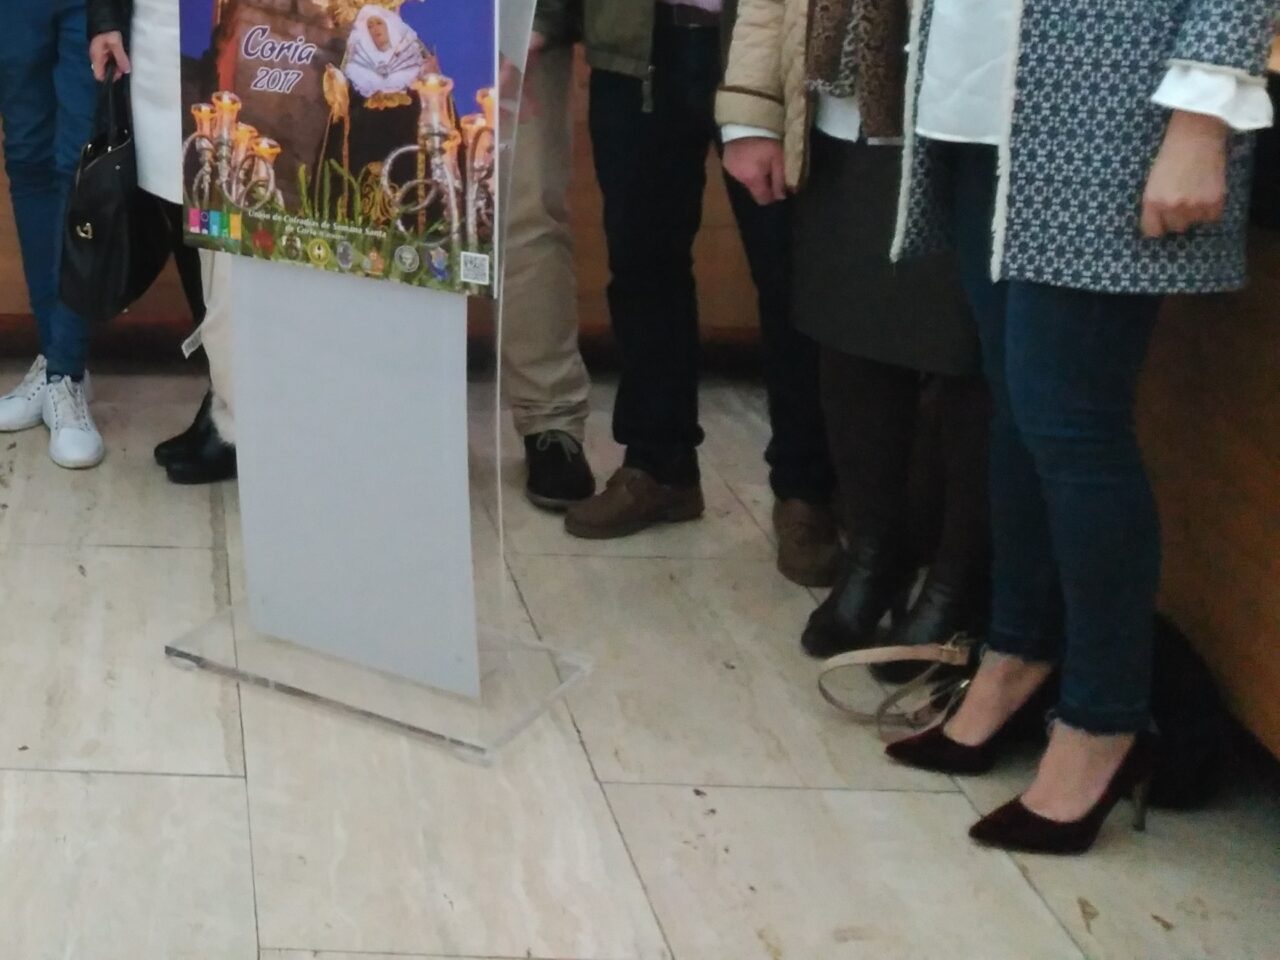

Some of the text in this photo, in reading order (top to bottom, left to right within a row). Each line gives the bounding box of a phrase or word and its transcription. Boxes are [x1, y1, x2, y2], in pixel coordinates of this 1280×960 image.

[242, 25, 317, 65] Coria
[251, 66, 304, 94] 2017
[272, 213, 283, 222] de
[320, 220, 331, 229] de
[333, 222, 363, 235] Semana
[365, 227, 387, 239] Santa
[296, 225, 318, 237] Coria
